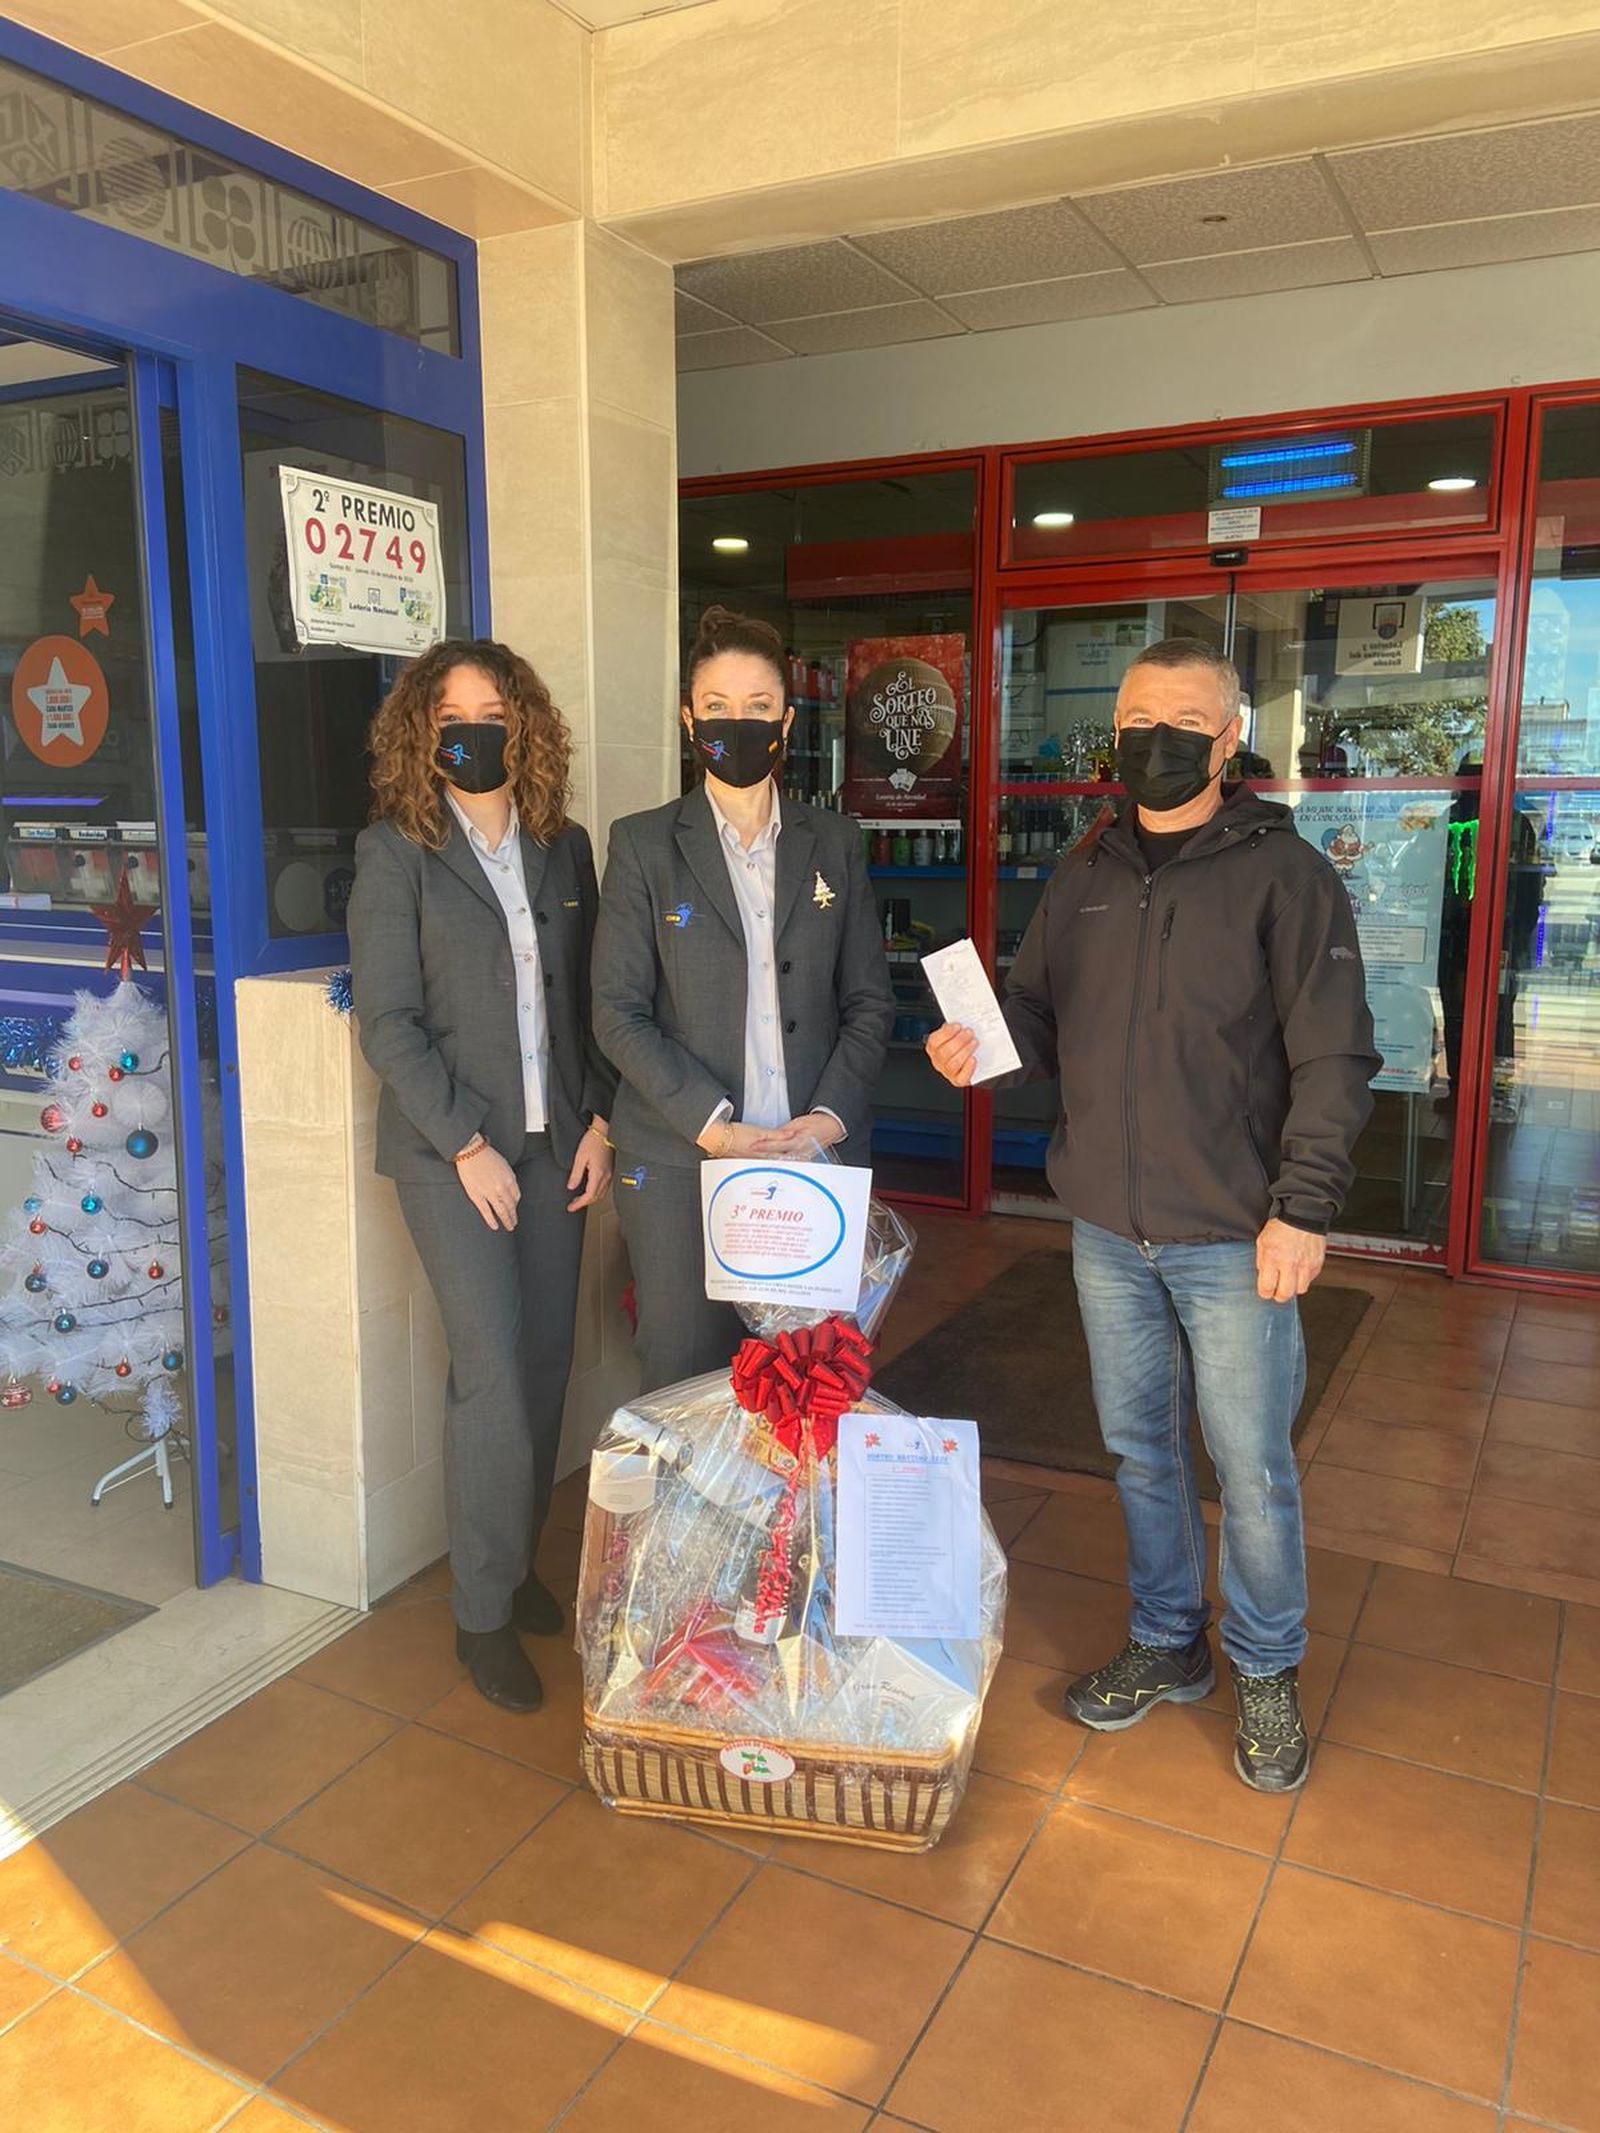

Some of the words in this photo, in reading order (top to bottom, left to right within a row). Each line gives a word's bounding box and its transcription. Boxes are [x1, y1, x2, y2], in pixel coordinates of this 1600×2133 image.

[312, 488, 330, 513] 2º
[341, 495, 416, 532] PREMIO
[304, 517, 426, 574] 02749
[372, 605, 399, 616] Nacional
[869, 687, 937, 723] SORTEO
[885, 714, 910, 730] QUE
[910, 706, 936, 730] NOS
[880, 728, 922, 760] UNE
[749, 1207, 805, 1224] PREMIO
